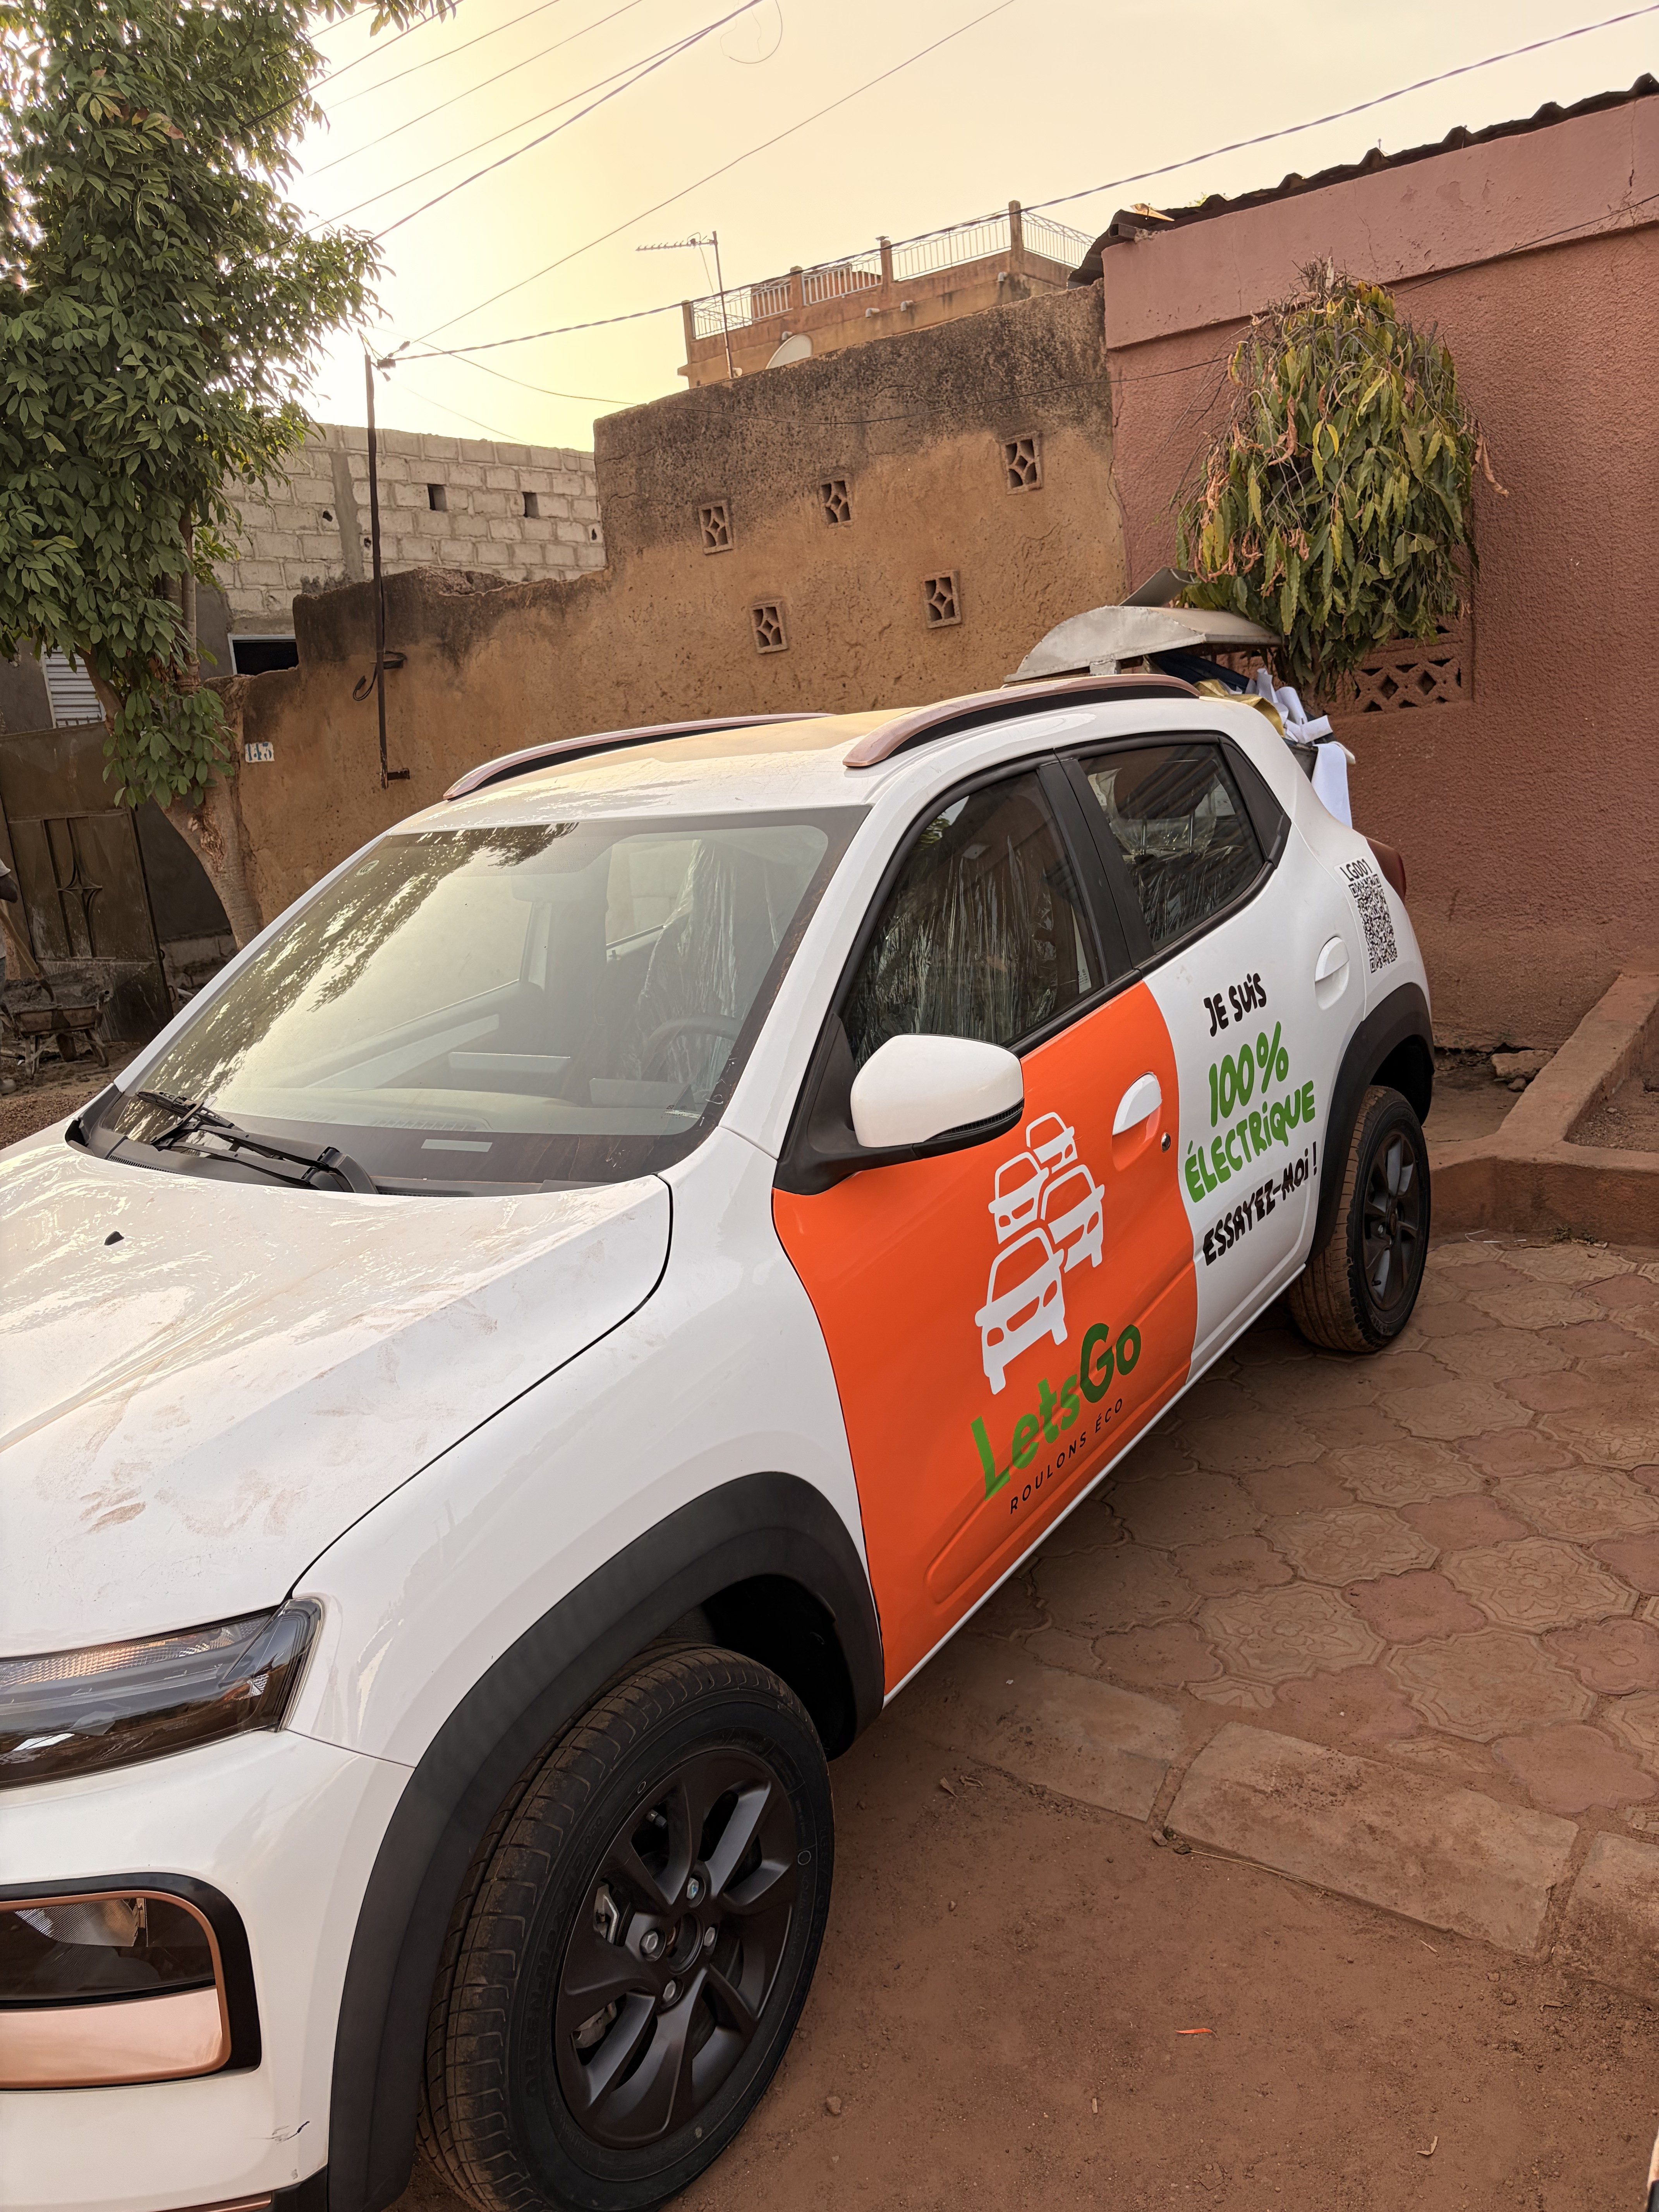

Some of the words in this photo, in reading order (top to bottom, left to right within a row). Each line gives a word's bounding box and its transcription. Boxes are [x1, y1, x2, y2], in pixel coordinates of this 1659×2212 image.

[1340, 859, 1372, 881] LG001
[1204, 993, 1229, 1037] JE
[1229, 973, 1267, 1022] SUIS
[1209, 1021, 1289, 1127] 100%
[1185, 1081, 1316, 1202] ÉLECTRIQUE
[1010, 1431, 1086, 1515] ROULONS
[1095, 1398, 1122, 1433] ÉCO
